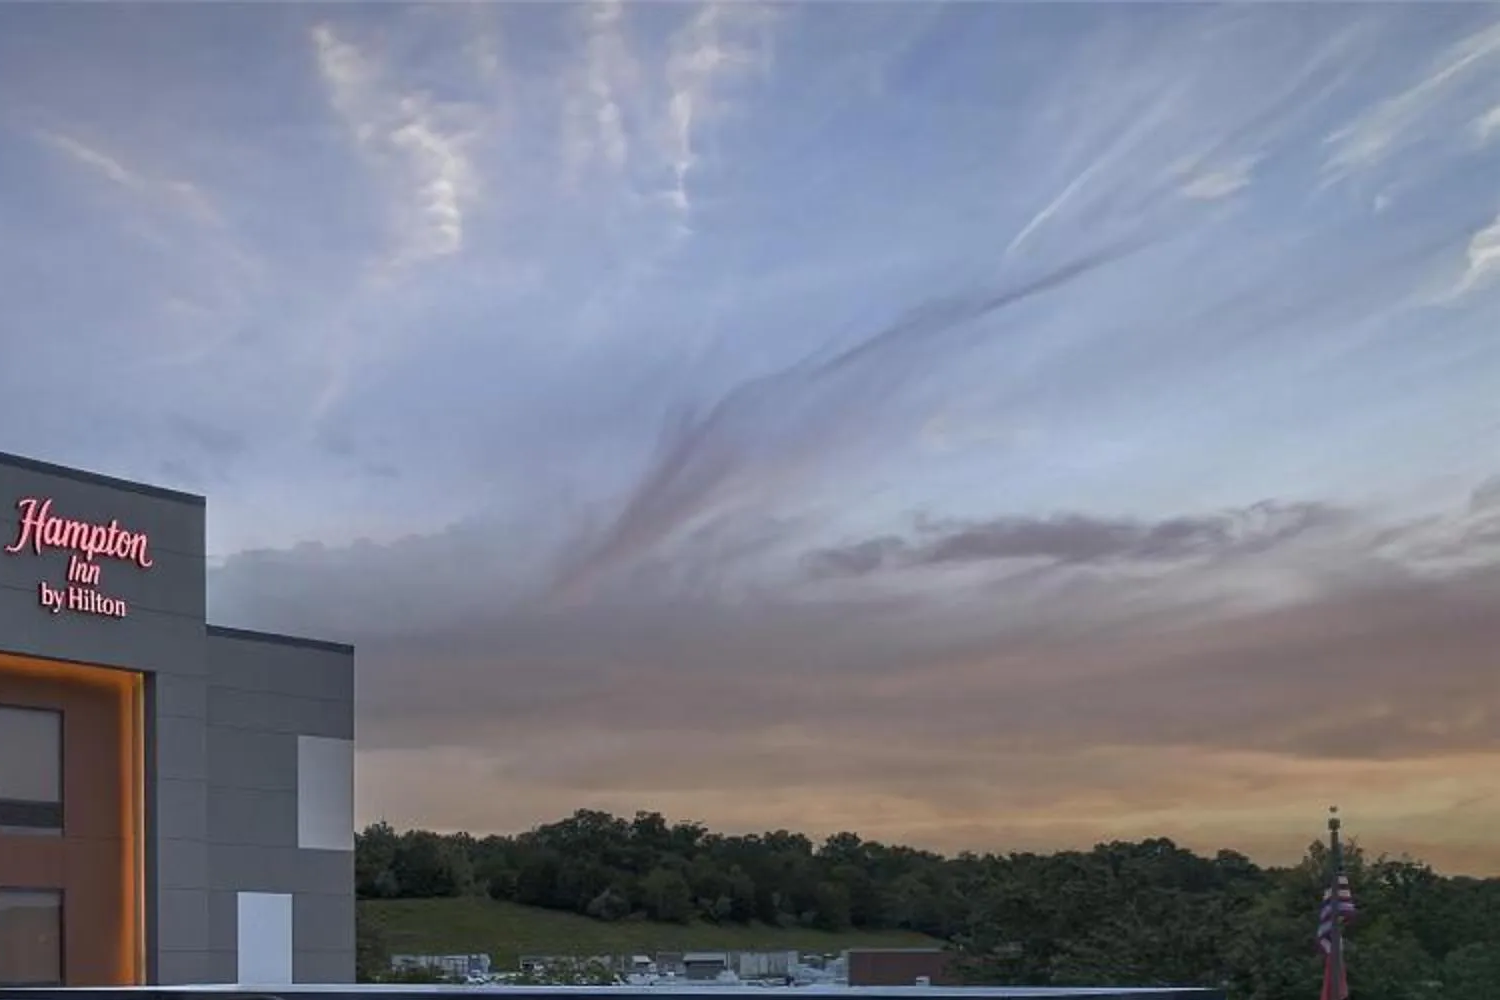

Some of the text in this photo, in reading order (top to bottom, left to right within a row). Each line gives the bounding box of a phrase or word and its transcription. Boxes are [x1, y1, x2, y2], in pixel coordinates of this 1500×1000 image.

[5, 498, 153, 567] Hampton
[68, 555, 101, 585] Inn
[41, 581, 126, 617] by Hilton
